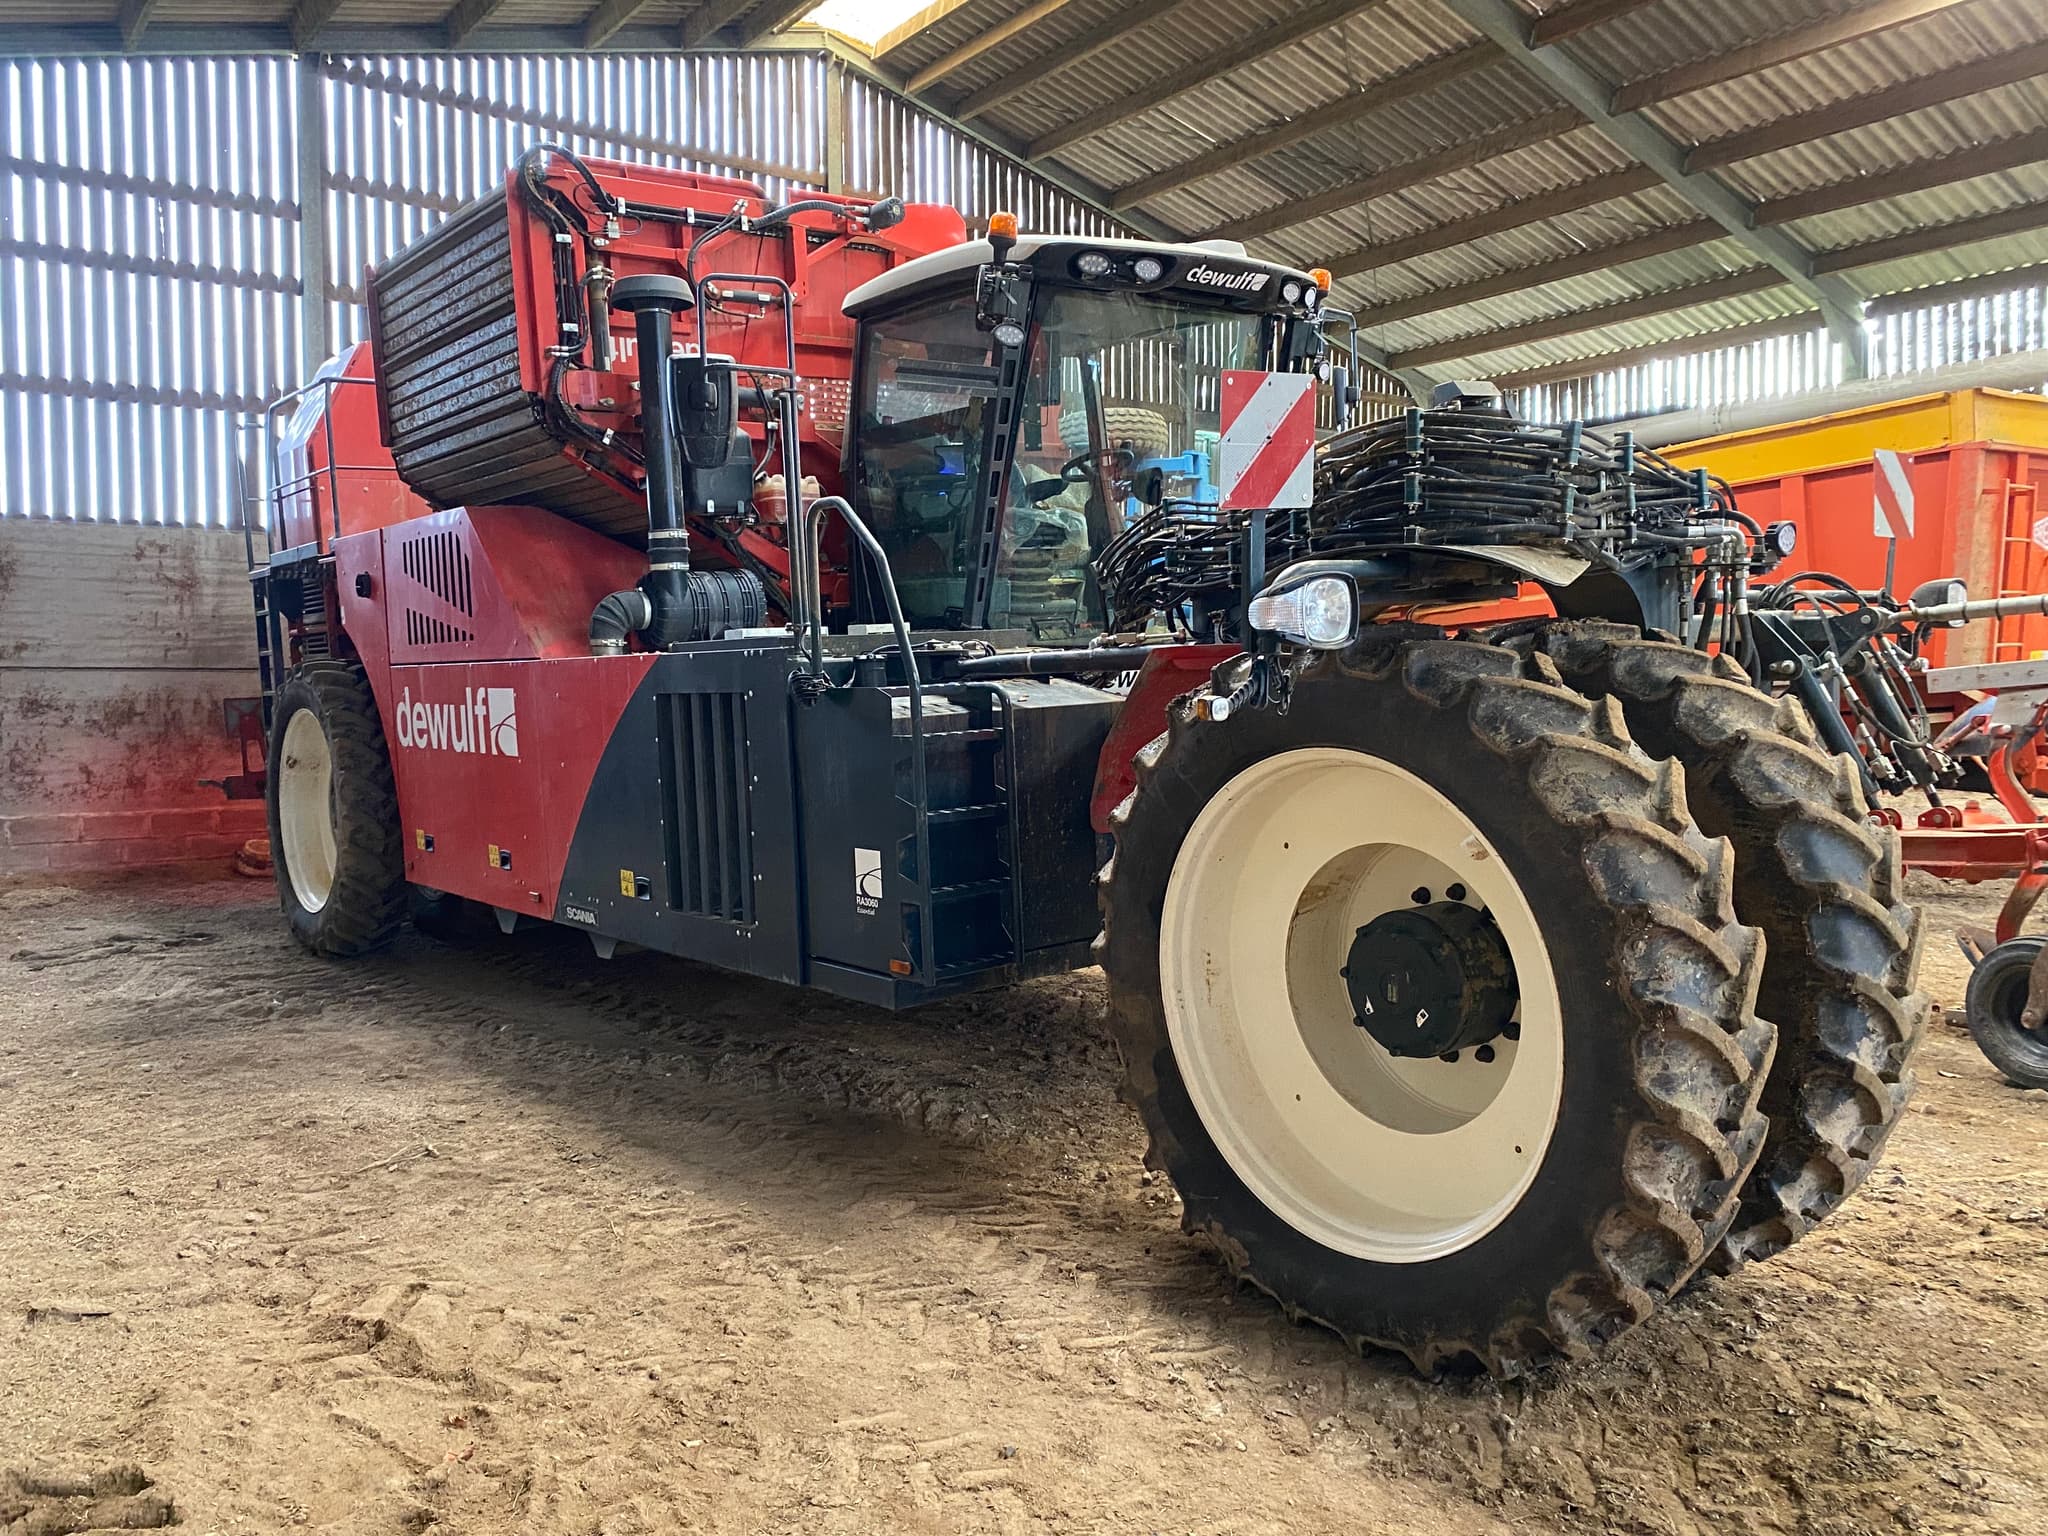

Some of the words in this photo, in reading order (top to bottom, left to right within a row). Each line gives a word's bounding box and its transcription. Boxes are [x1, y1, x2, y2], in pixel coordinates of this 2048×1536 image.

[1186, 264, 1256, 291] dewulf
[396, 686, 487, 754] dewulf
[856, 896, 879, 908] RA3060
[566, 906, 596, 925] SCANIA
